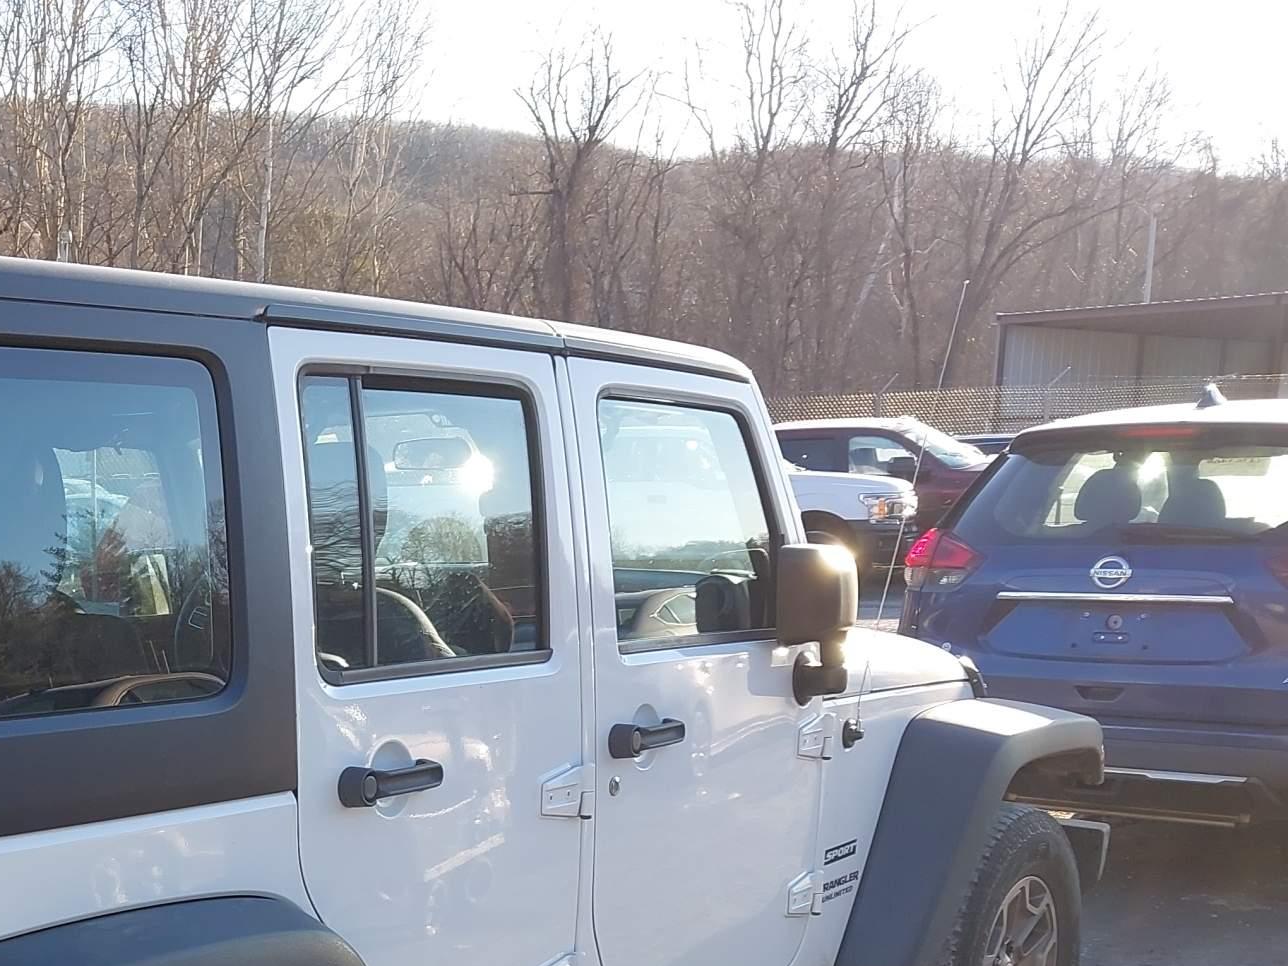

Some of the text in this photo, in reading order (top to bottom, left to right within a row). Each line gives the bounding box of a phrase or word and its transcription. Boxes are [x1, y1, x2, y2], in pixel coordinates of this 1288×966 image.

[1093, 569, 1128, 577] NISSAN
[824, 842, 856, 862] SPORT
[822, 870, 859, 892] RANGLER
